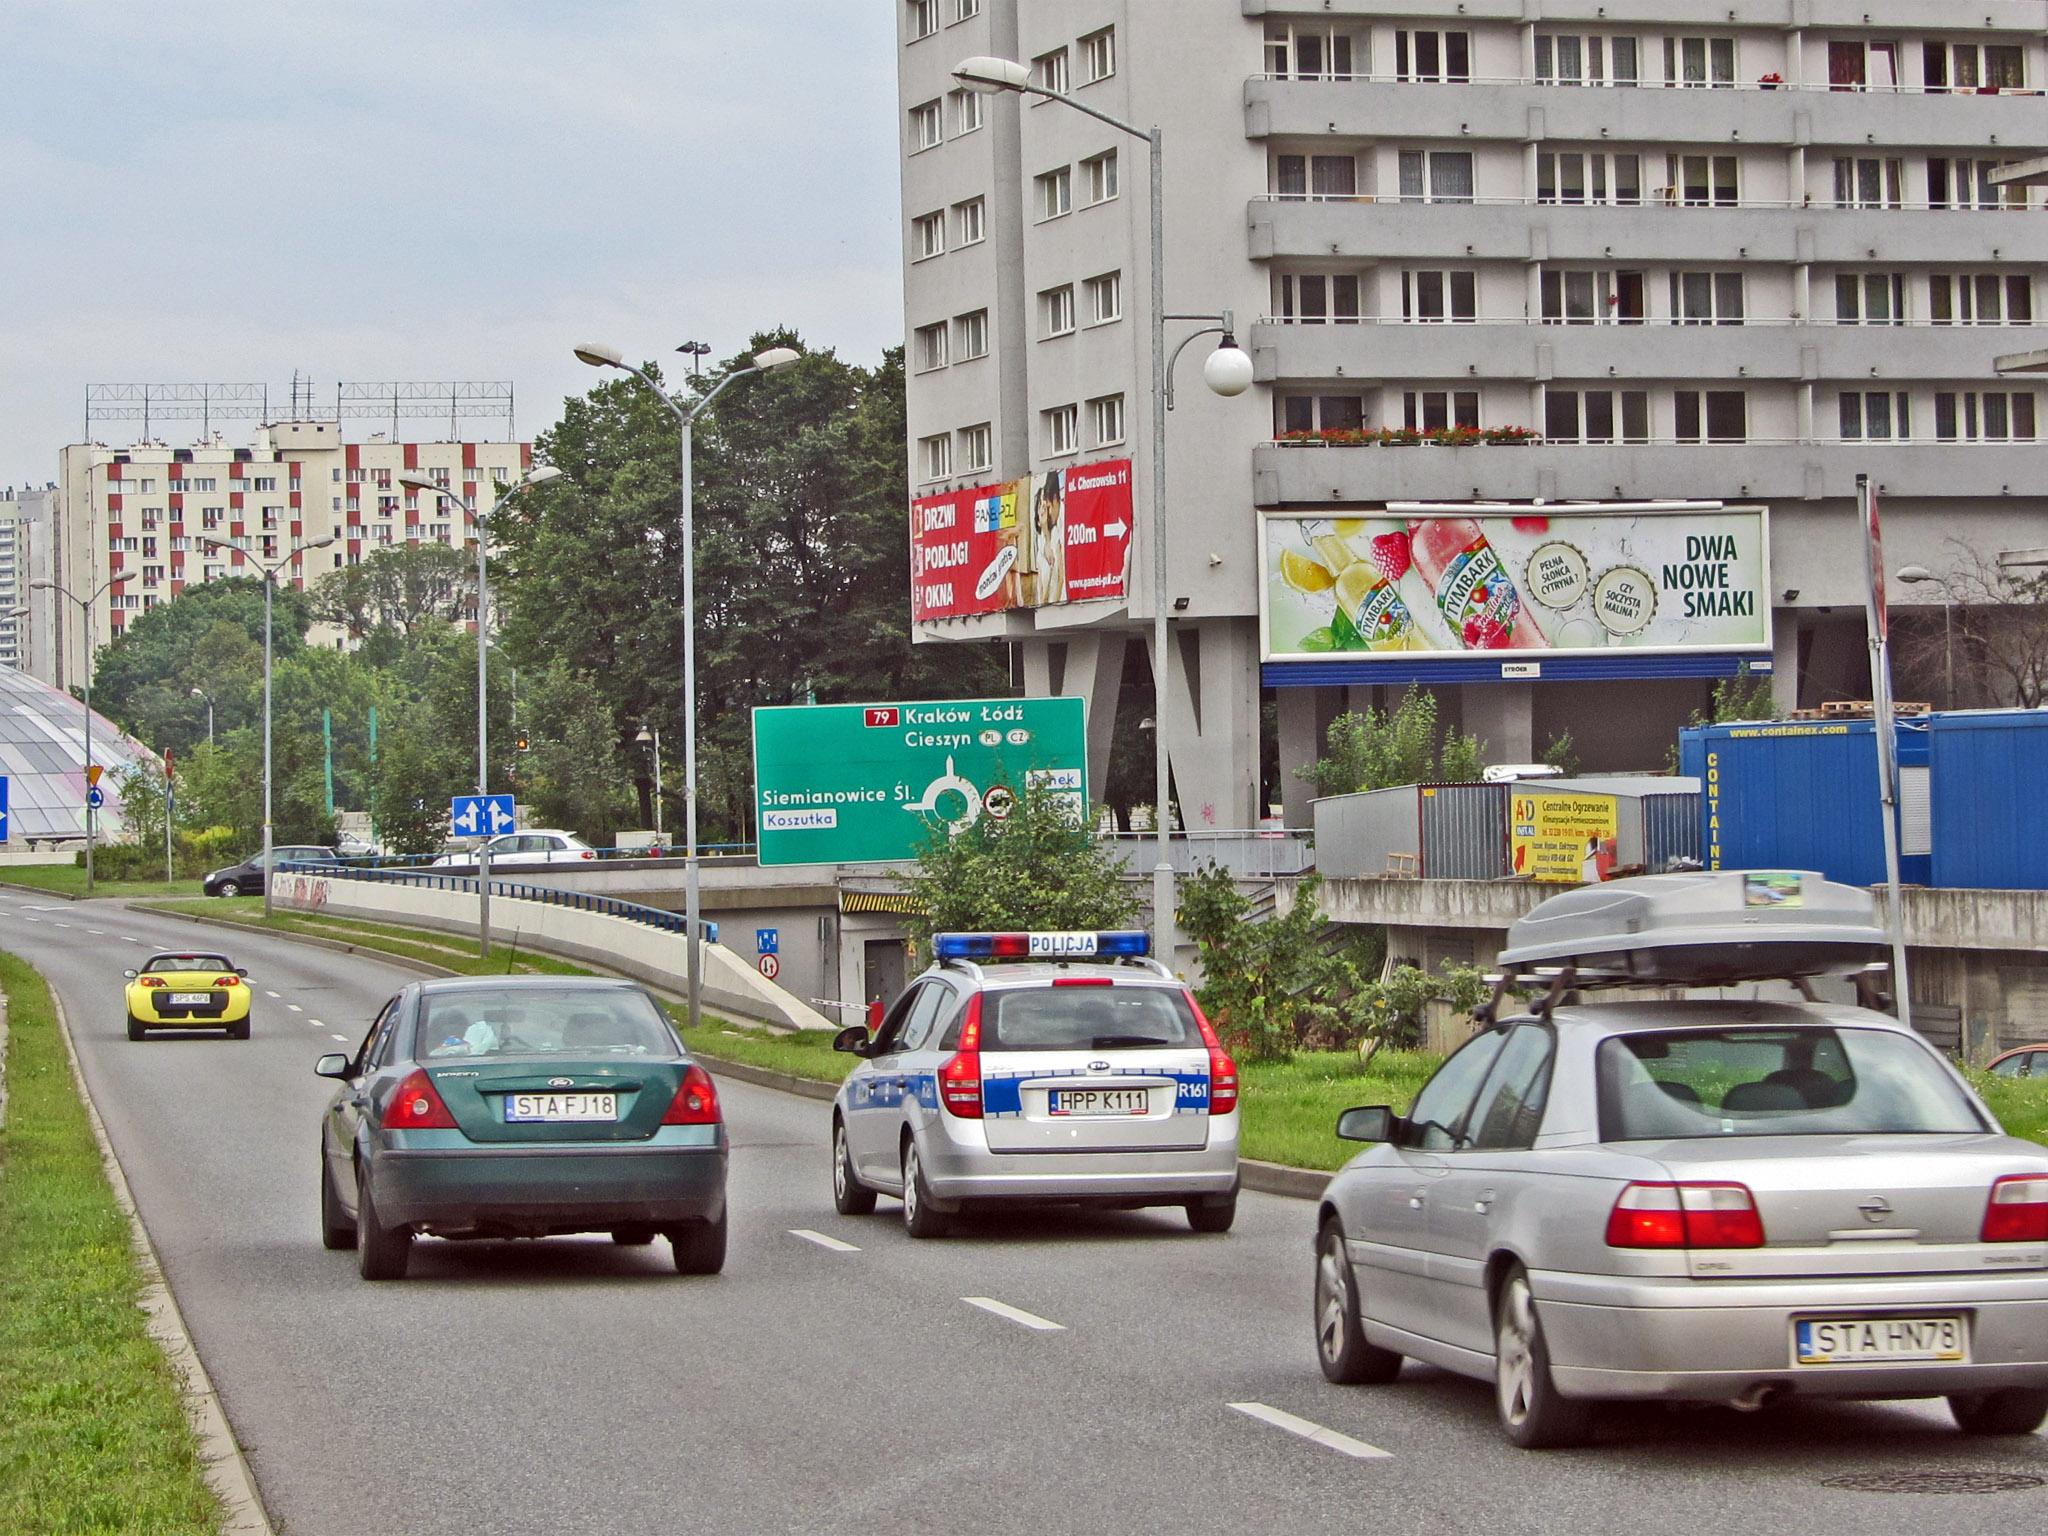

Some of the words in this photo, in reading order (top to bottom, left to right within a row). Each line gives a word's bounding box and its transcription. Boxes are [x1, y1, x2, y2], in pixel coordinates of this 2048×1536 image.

[1078, 472, 1117, 490] Chorzowska
[1118, 470, 1127, 485] 11
[924, 503, 956, 532] DRZWI
[1067, 523, 1097, 546] 200m
[925, 541, 969, 571] PODŁOGI
[1686, 535, 1738, 562] DWA
[1446, 550, 1495, 617] TYMBARK
[1541, 575, 1575, 595] CYTRYNA
[1663, 563, 1729, 590] NOWE
[925, 582, 954, 609] OKNA
[1619, 583, 1635, 594] CZY
[1605, 590, 1641, 609] SOCZYSTA
[1684, 590, 1754, 618] SMAKI
[1362, 587, 1394, 635] TYMBARK
[1603, 602, 1633, 618] MALINA
[873, 711, 890, 725] 79
[905, 707, 971, 724] Kraków
[980, 705, 1024, 722] Łódź
[905, 731, 971, 750] Cieszyn
[985, 733, 996, 743] PL
[1010, 732, 1024, 743] CZ
[1729, 725, 1848, 738] www.containex.com
[1032, 773, 1075, 787] Rnek
[762, 788, 886, 806] Siemianowice
[894, 781, 915, 801] Śl.
[1542, 800, 1572, 812] Centralne
[1572, 801, 1609, 815] Ogrzewanie
[767, 812, 833, 827] Koszutka
[1031, 935, 1095, 952] POLICJA
[1179, 1082, 1207, 1098] R161
[519, 1097, 559, 1115] STA
[565, 1096, 613, 1114] FJ18
[1061, 1092, 1098, 1109] HPP
[1103, 1092, 1142, 1109] K111
[1818, 1324, 1878, 1353] STA
[1888, 1322, 1956, 1351] HN78
